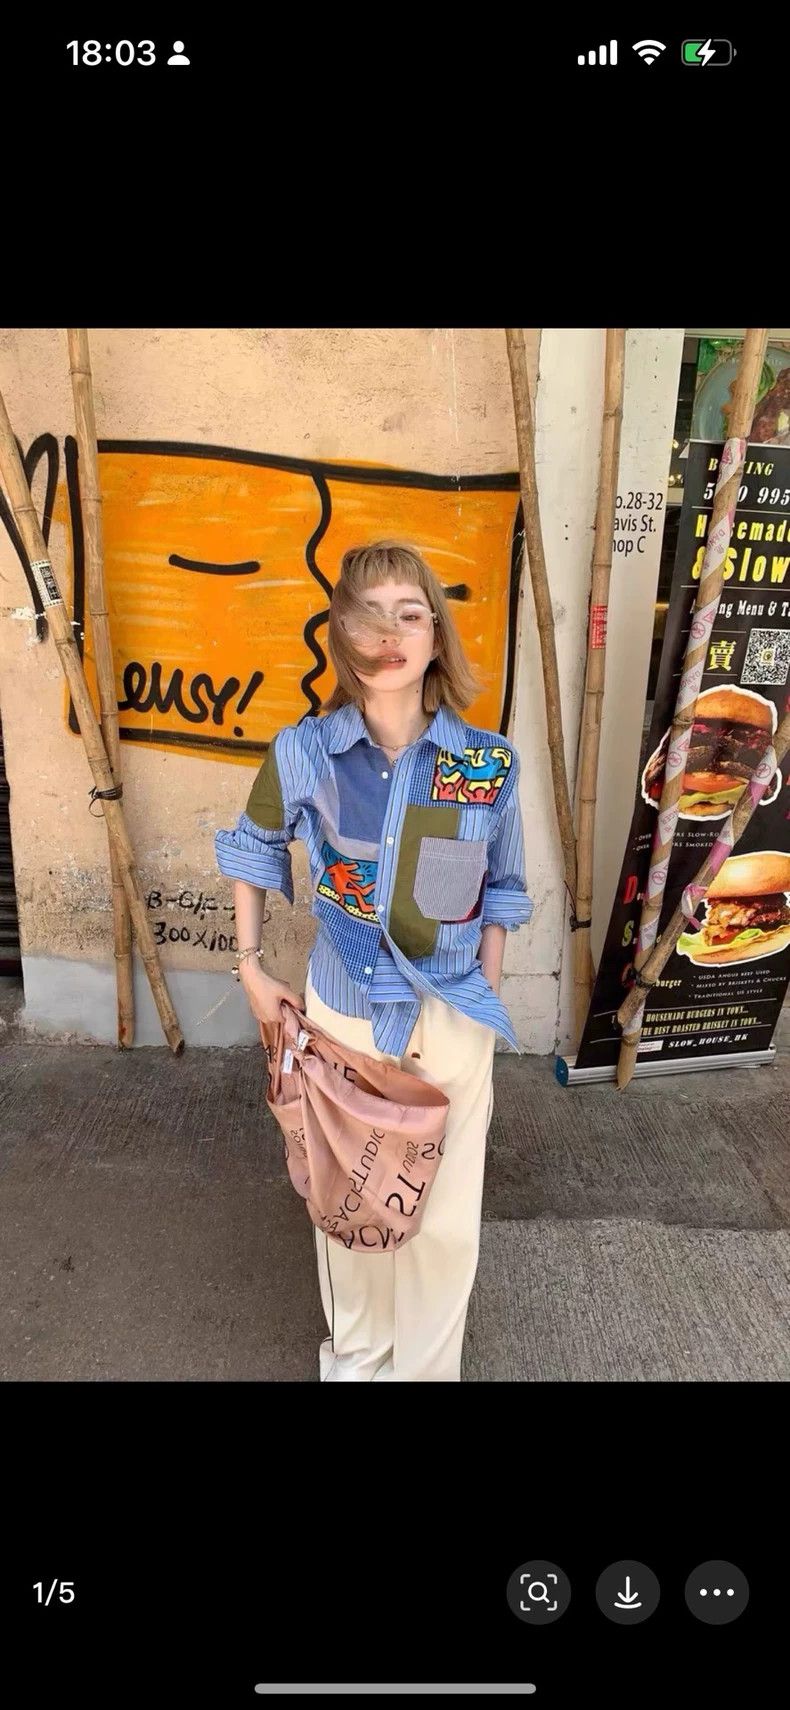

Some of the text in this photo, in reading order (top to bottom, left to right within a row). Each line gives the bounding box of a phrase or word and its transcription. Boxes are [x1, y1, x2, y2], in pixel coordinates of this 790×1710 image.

[708, 458, 774, 476] BING
[615, 491, 663, 510] o.28-32
[613, 514, 656, 532] avis St.
[613, 536, 646, 557] op C
[737, 600, 764, 616] Menu
[768, 601, 777, 616] &
[654, 979, 682, 989] burger
